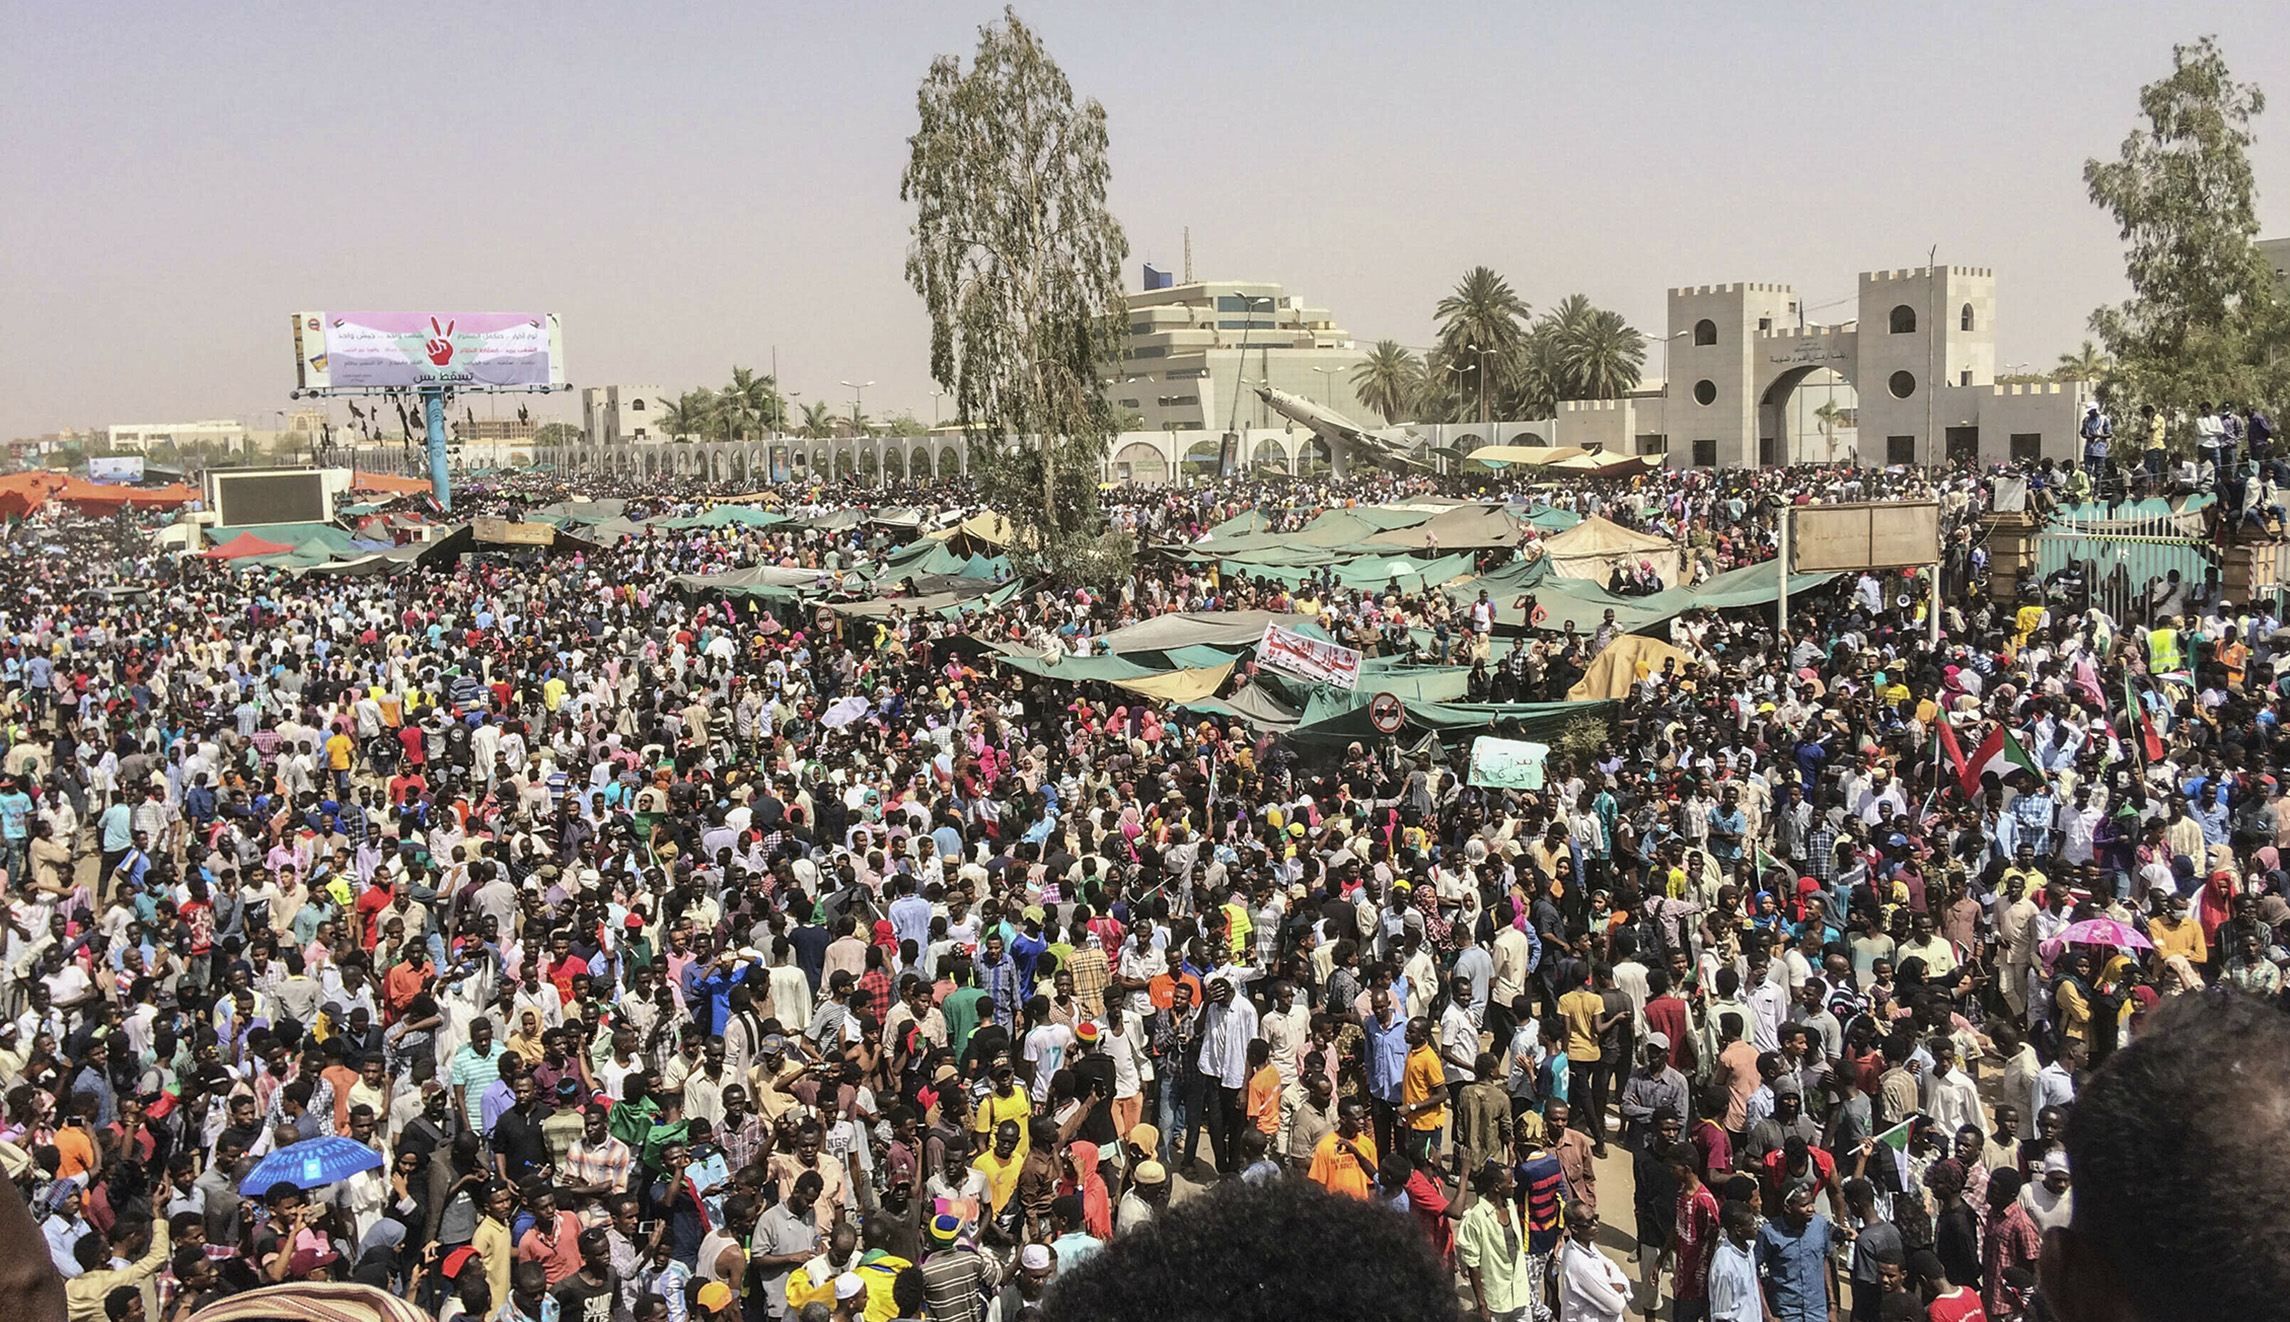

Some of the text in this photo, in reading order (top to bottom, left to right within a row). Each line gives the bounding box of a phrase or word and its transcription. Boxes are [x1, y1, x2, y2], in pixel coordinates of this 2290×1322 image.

[412, 370, 474, 384] تسقط بس
[1046, 1046, 1062, 1071] 17
